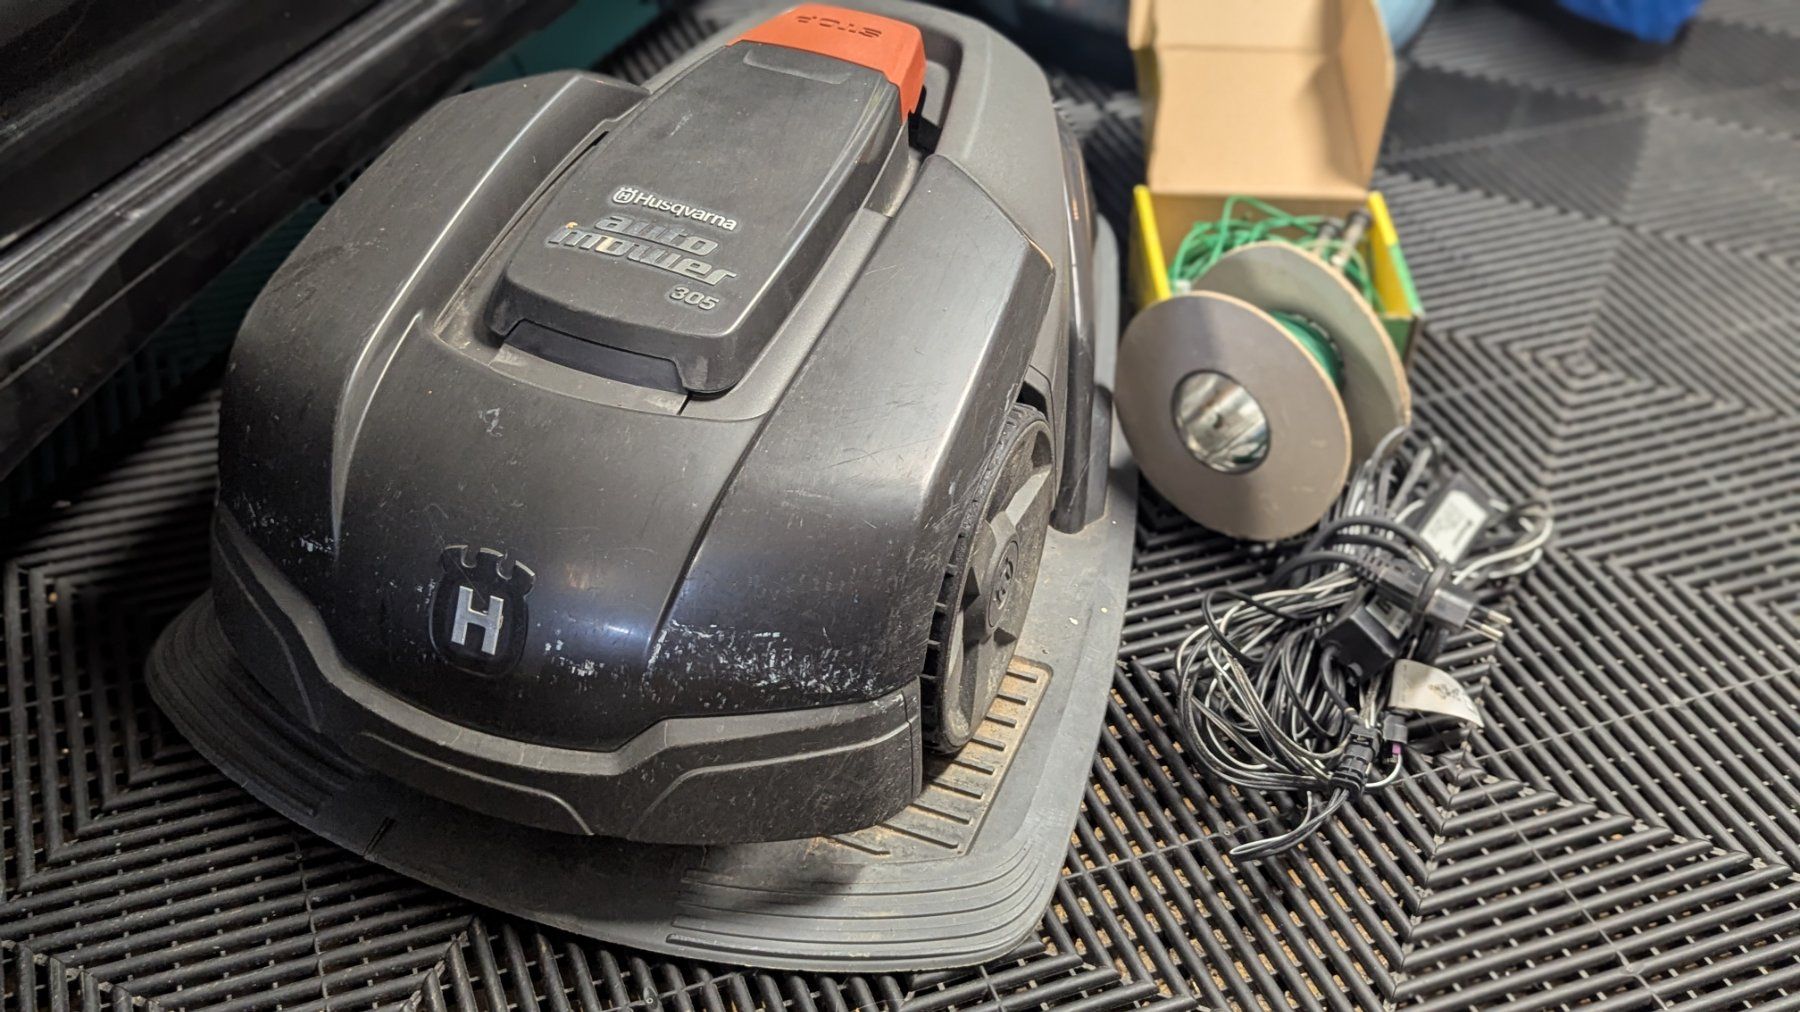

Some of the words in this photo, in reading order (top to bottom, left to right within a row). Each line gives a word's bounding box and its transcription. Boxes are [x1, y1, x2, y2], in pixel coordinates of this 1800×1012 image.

[796, 15, 882, 38] STOP
[633, 192, 737, 230] Husqvarna
[548, 221, 737, 286] mower
[594, 215, 718, 255] auto
[669, 286, 719, 310] 305
[451, 585, 504, 655] H
